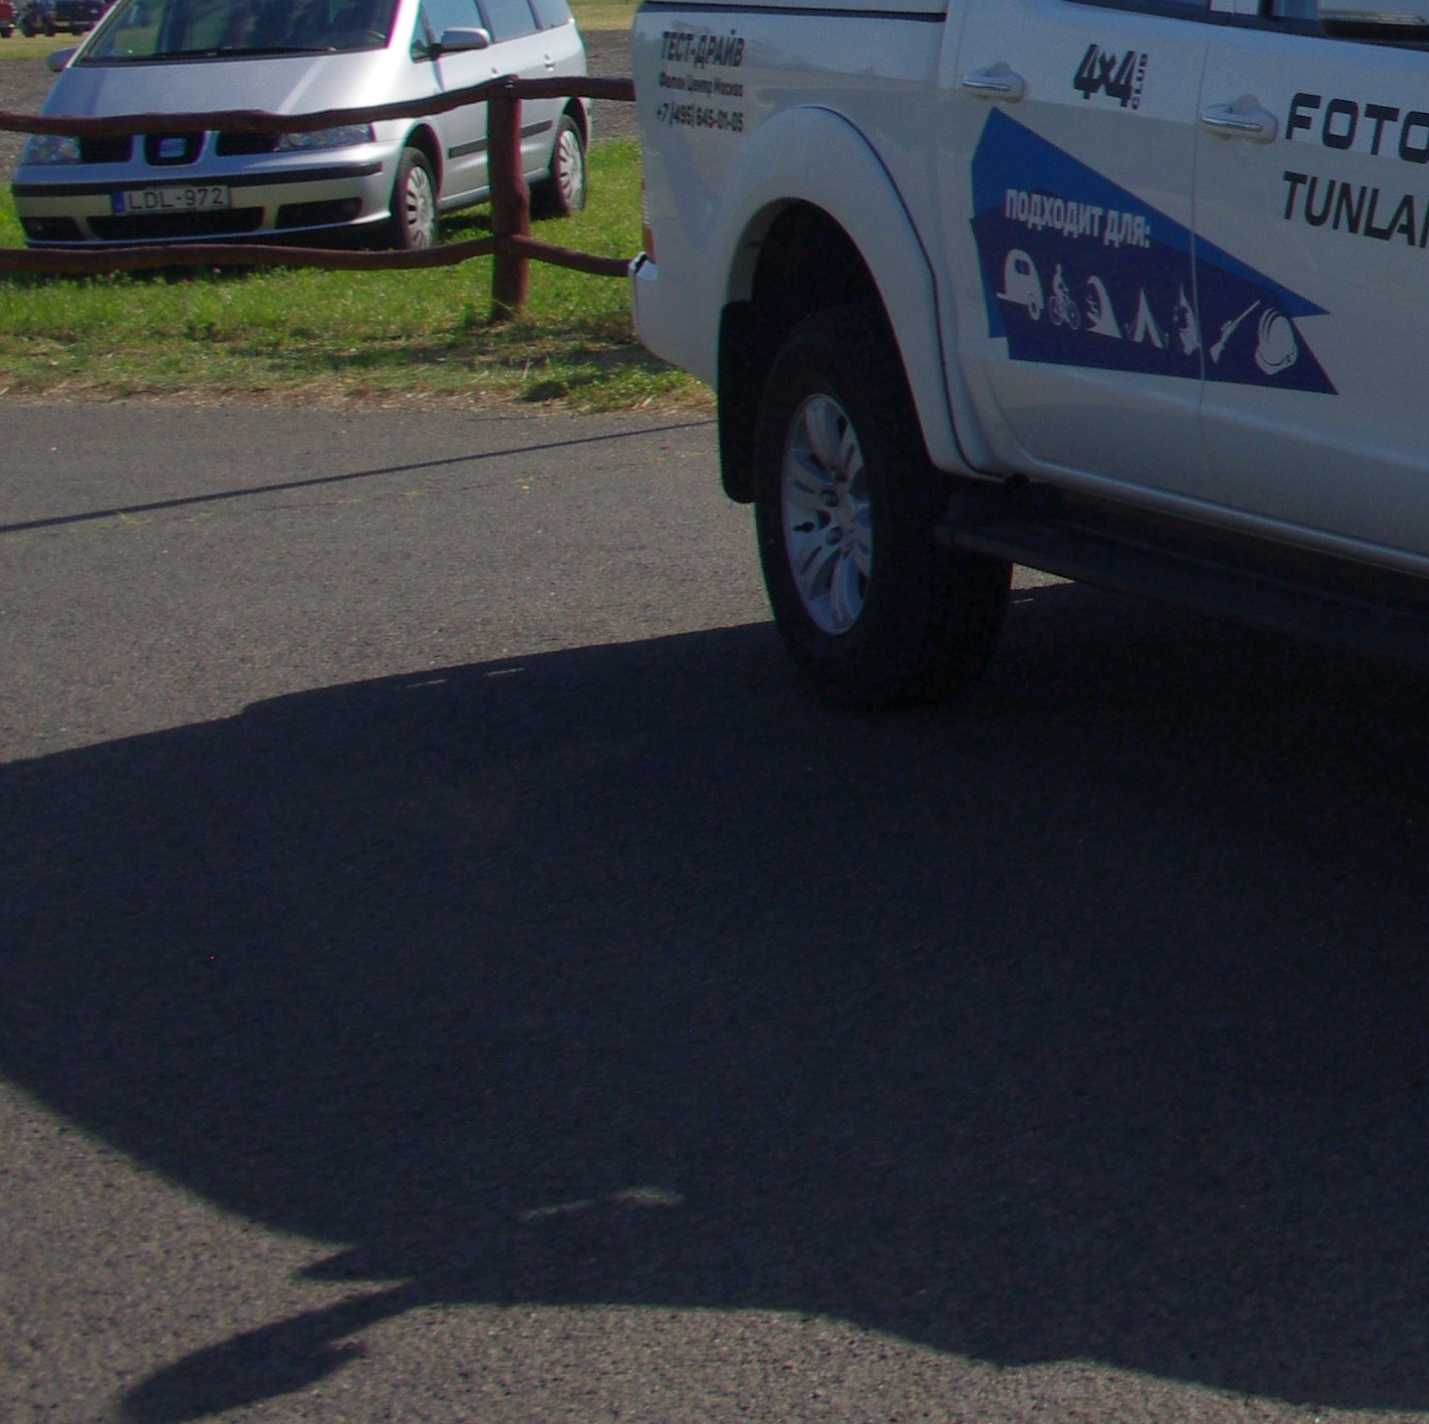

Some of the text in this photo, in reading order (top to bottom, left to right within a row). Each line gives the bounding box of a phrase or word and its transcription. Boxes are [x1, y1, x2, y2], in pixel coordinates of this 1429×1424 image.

[662, 29, 745, 69] ТЕСТ-ДРАЙВ
[1073, 43, 1138, 108] 4x4
[128, 187, 224, 210] LDL-972
[1004, 188, 1151, 249] ПОДХОДИТ ДЛЯ:
